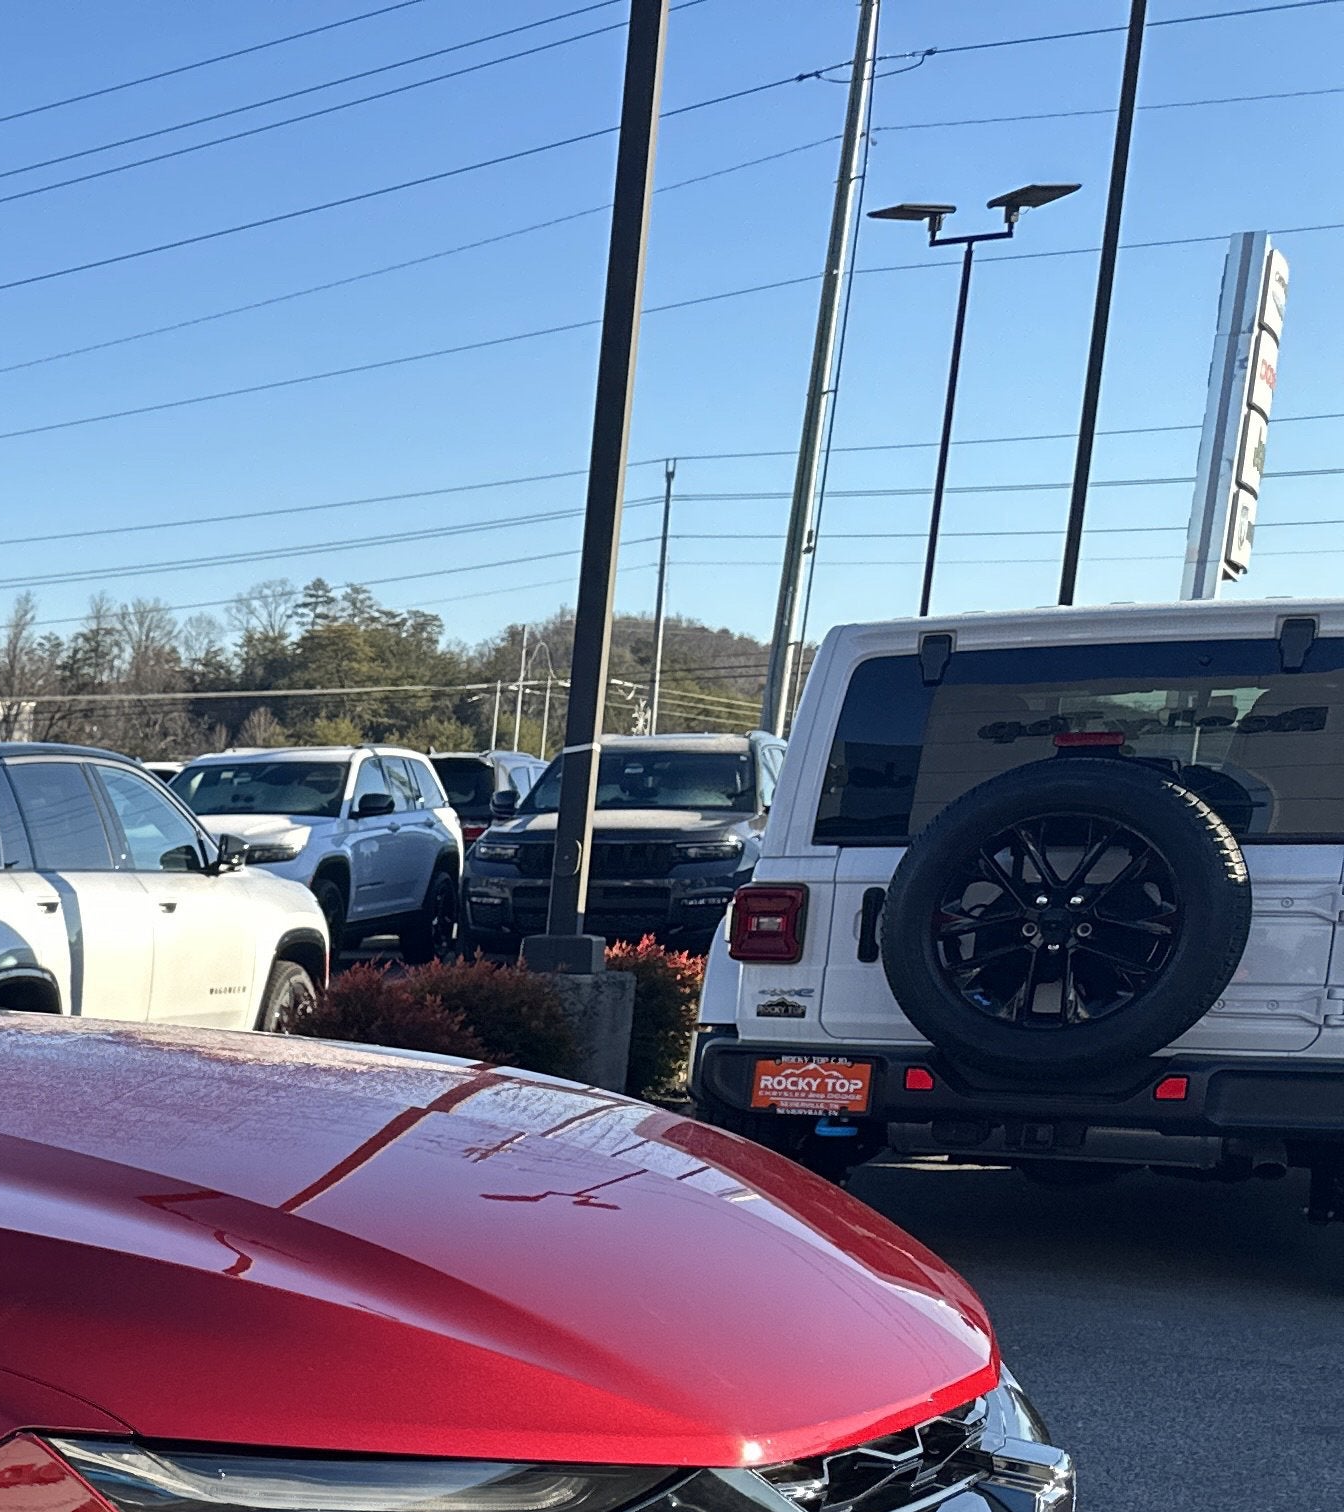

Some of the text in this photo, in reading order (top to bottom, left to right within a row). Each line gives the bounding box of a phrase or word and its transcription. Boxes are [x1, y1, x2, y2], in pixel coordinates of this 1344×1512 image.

[781, 1055, 810, 1064] ROCKY
[813, 1056, 829, 1065] TOP
[760, 1075, 863, 1093] ROCKY TOP
[758, 1089, 807, 1098] CHRYSLER
[827, 1093, 863, 1101] DODGE
